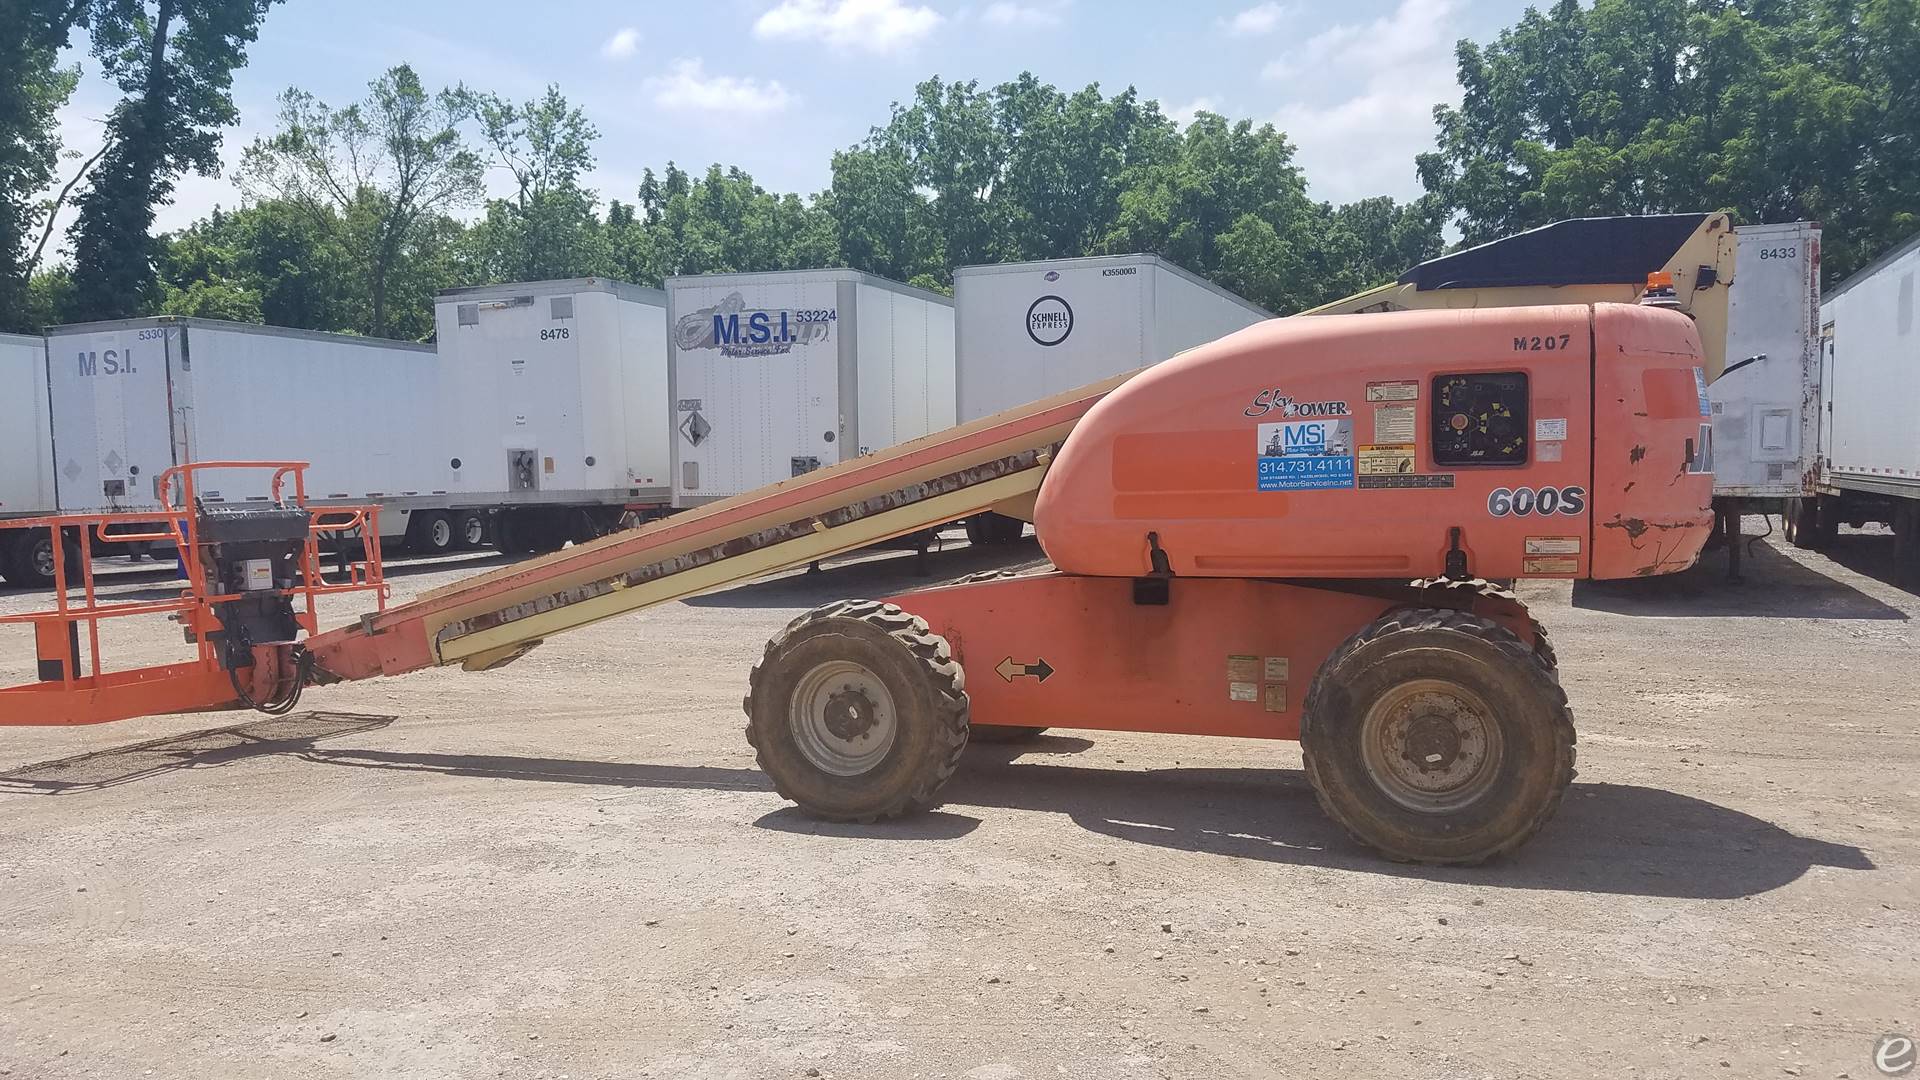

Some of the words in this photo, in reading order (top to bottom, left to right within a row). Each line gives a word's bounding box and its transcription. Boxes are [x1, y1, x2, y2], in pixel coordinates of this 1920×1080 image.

[1760, 247, 1797, 260] 8433
[1102, 268, 1136, 277] K3550003
[796, 310, 836, 323] 53224
[1032, 312, 1067, 322] SCHNELL
[713, 311, 796, 344] M.S.I.
[1032, 321, 1067, 329] EXPRESS
[541, 328, 569, 340] 8478
[1513, 334, 1570, 351] M207
[1284, 423, 1326, 446] MSi
[1260, 459, 1351, 474] 314.731.4111
[1260, 480, 1353, 489] www.MotorServiceInc.net
[1487, 486, 1586, 517] 600S
